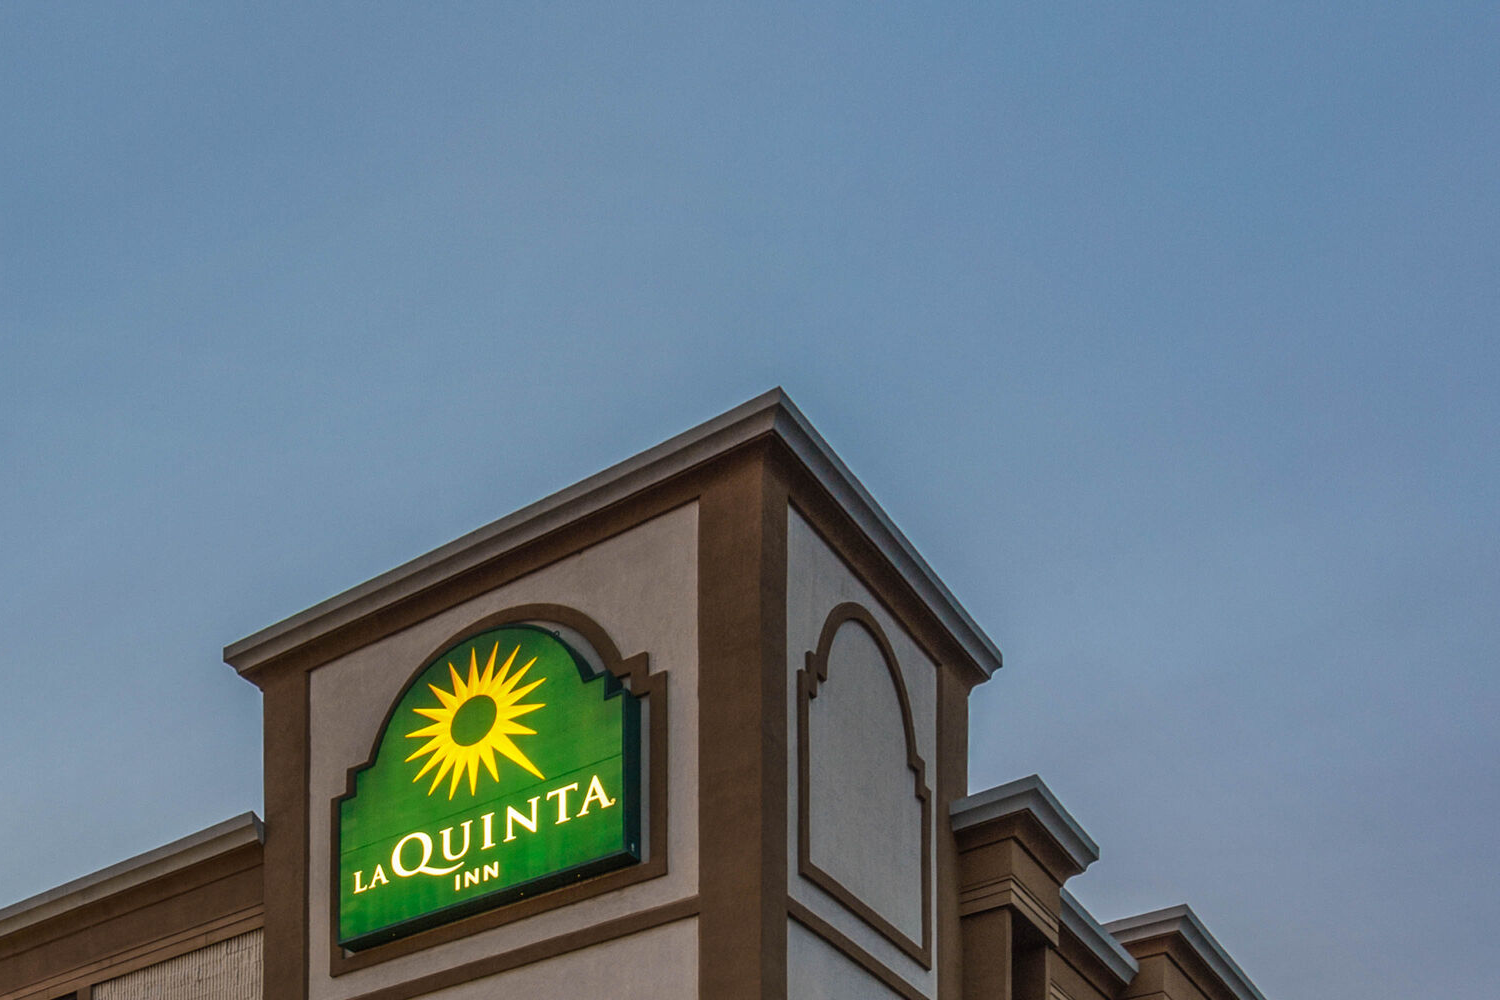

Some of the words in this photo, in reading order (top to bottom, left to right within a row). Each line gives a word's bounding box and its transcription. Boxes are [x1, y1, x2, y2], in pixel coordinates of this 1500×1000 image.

[353, 864, 389, 894] LA
[391, 774, 616, 878] QUINTA
[455, 861, 499, 891] INN
